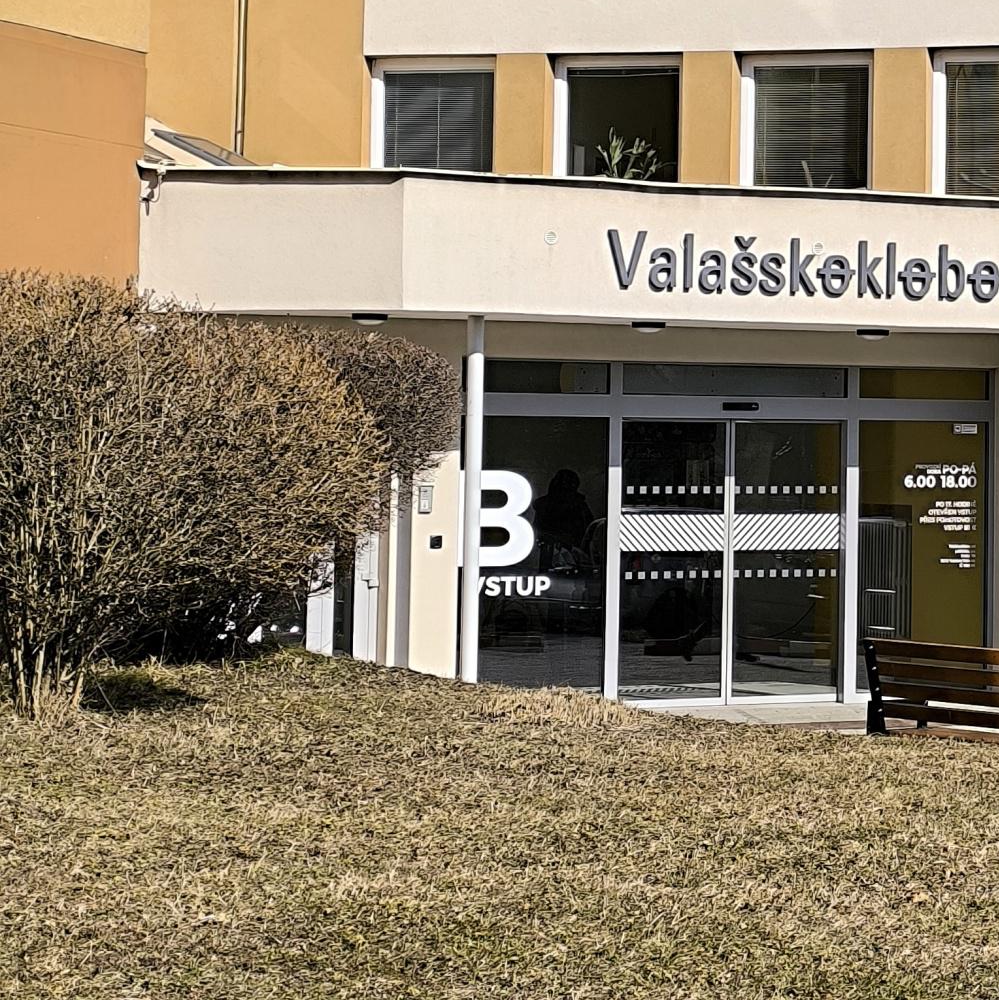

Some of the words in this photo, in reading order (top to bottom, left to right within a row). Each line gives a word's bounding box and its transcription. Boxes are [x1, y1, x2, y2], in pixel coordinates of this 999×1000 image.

[942, 462, 977, 474] PO-PÁ
[904, 475, 936, 488] 6.00
[940, 475, 977, 488] 18.00
[457, 469, 535, 568] B
